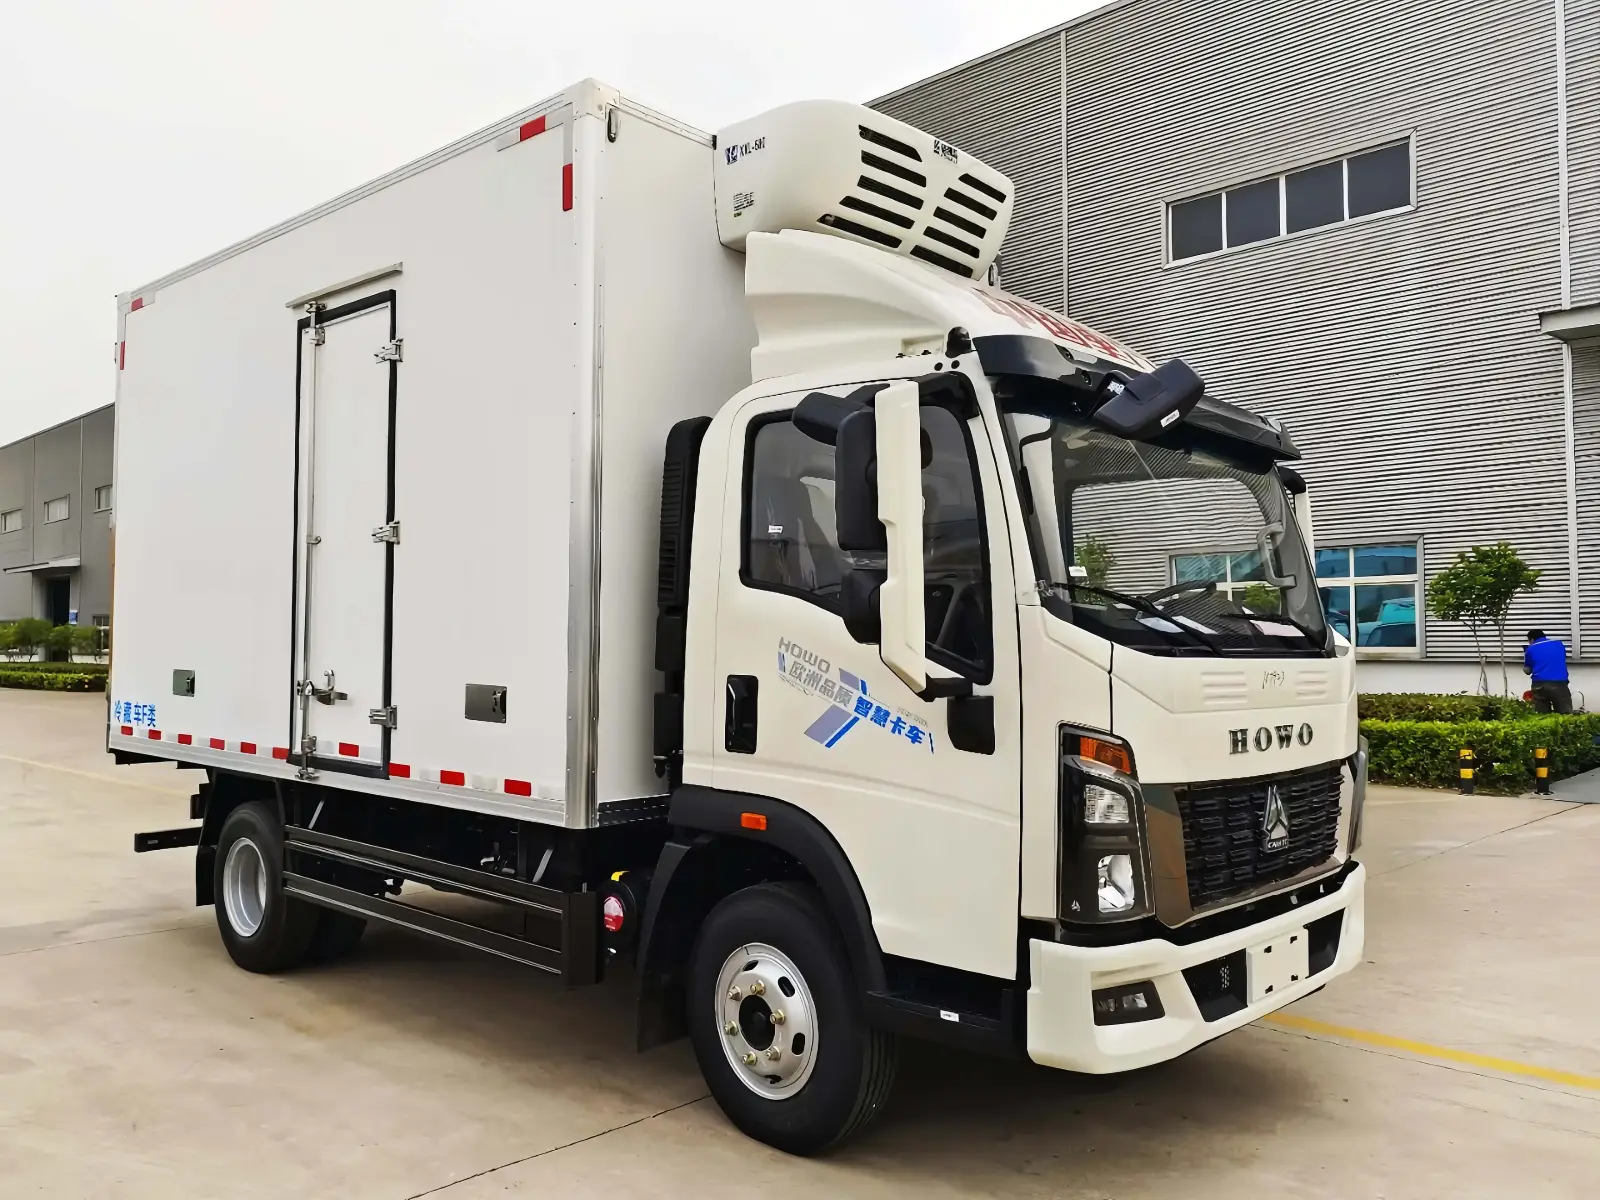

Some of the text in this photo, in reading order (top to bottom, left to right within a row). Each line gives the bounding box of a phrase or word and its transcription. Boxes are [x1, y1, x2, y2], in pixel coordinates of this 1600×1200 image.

[778, 636, 831, 674] HOWO
[789, 661, 854, 707] 欧洲品质
[853, 695, 926, 745] 智慧卡车
[1228, 722, 1314, 755] HOWO
